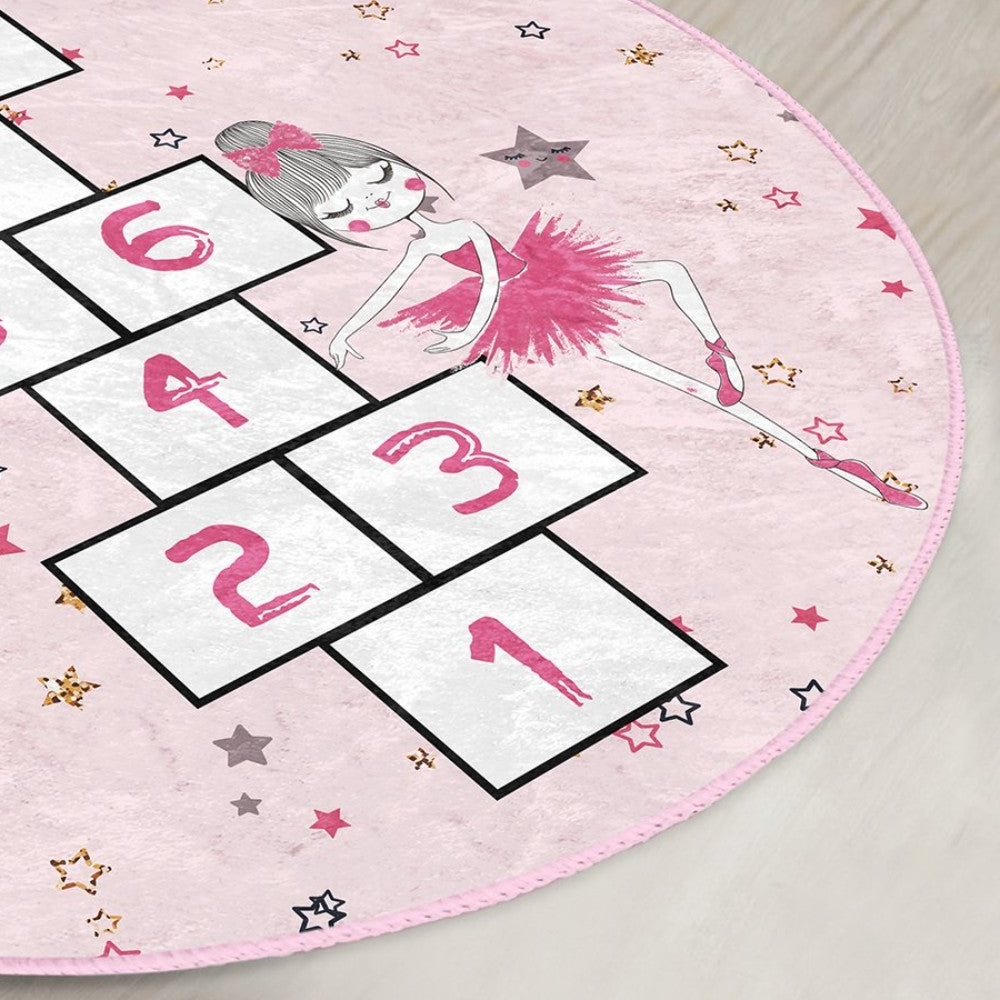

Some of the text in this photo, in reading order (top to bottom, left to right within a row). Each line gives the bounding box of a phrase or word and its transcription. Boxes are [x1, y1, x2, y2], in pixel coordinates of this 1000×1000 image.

[101, 200, 215, 272] 6
[144, 353, 248, 428] 4
[373, 421, 519, 515] 3
[165, 524, 319, 628] 2
[469, 616, 592, 707] 1
